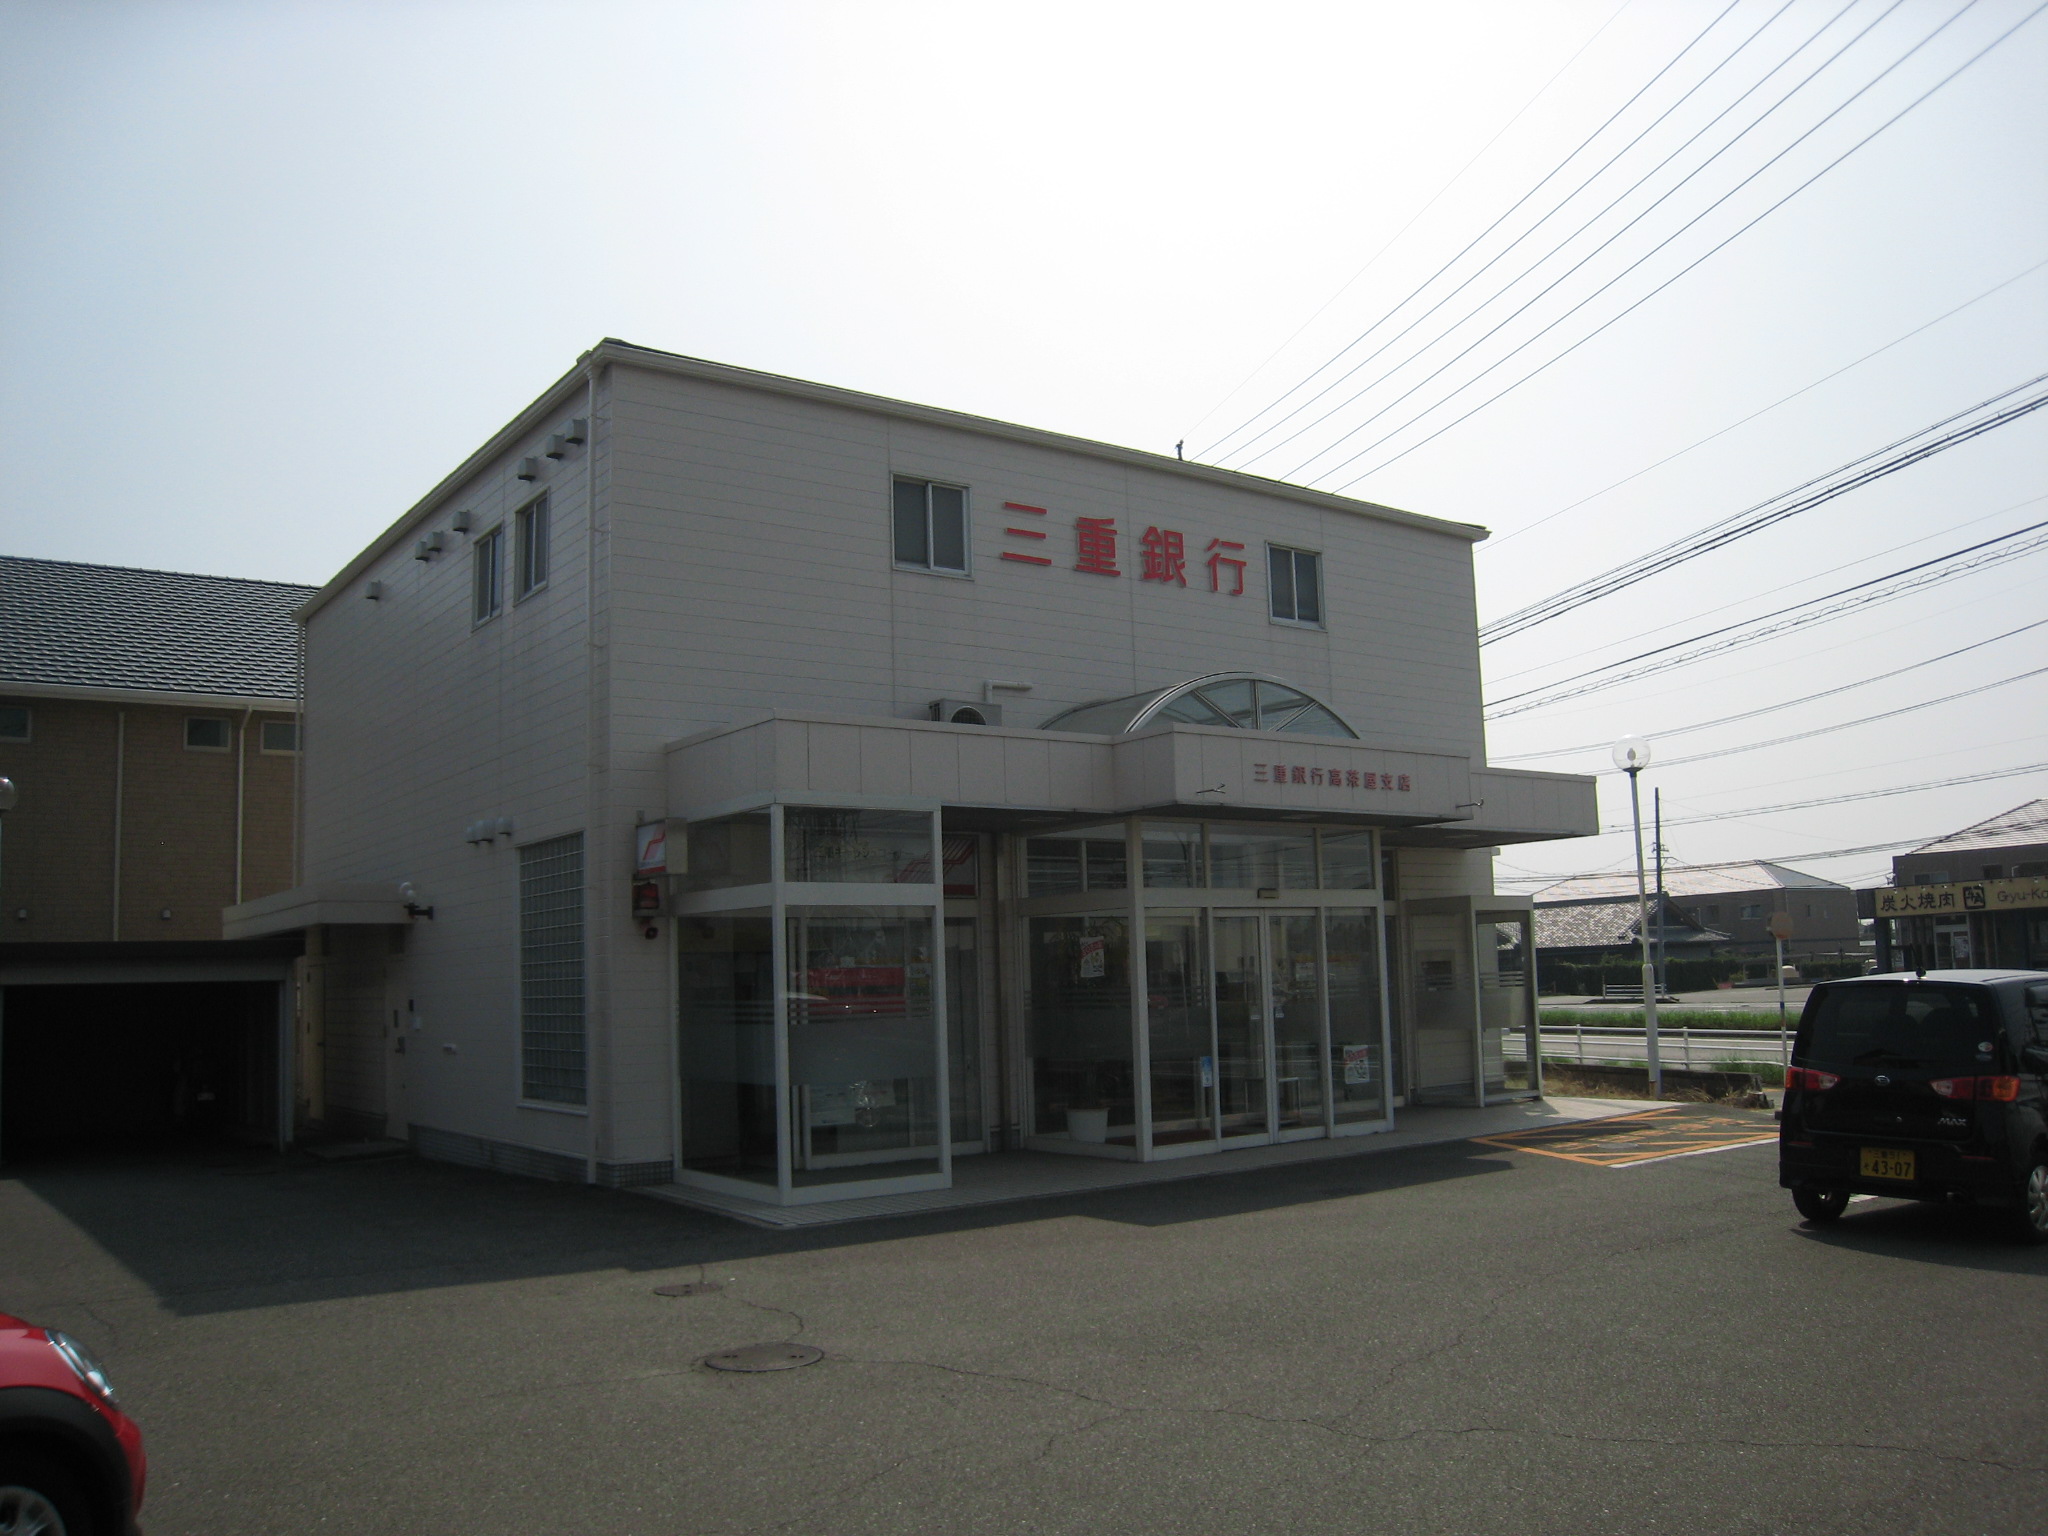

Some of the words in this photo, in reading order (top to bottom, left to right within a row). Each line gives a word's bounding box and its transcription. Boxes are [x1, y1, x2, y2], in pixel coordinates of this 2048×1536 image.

[1000, 501, 1247, 595] 三重銀行
[1880, 891, 1955, 912] 炭火焼肉
[1937, 1117, 1967, 1126] MAX
[1872, 1160, 1912, 1177] 43-07
